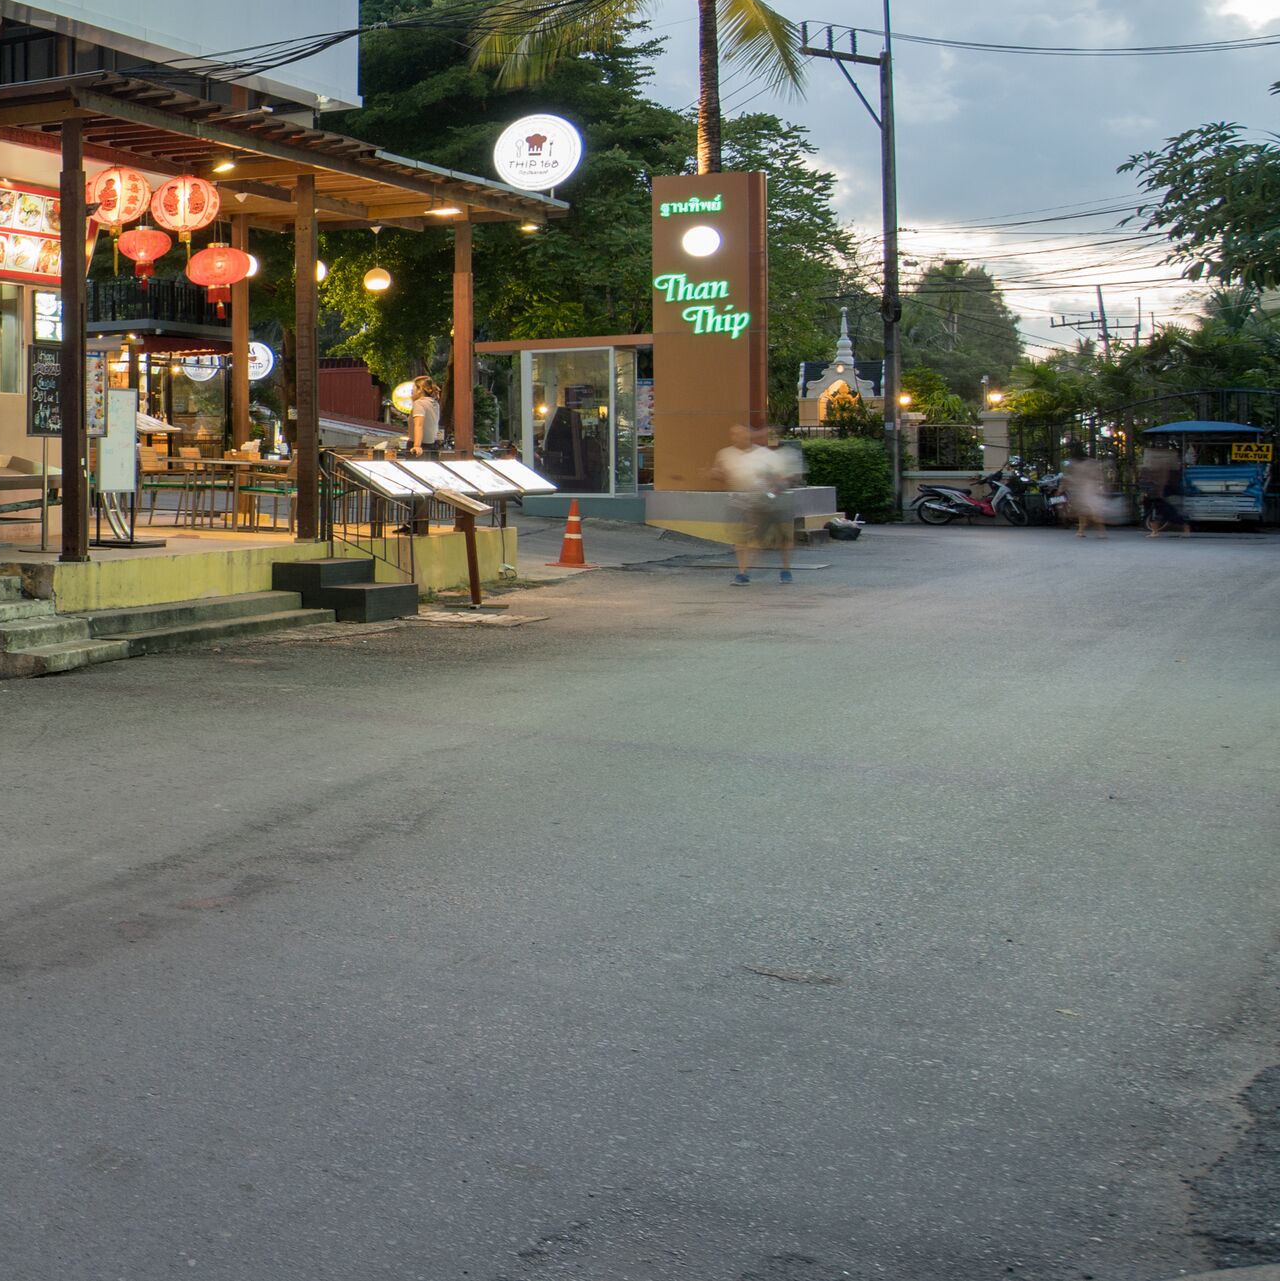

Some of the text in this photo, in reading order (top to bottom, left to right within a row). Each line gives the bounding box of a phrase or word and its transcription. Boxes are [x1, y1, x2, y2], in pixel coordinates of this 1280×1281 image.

[509, 159, 559, 168] THIP 168
[660, 194, 722, 216] ฐานทิพย์
[654, 273, 729, 302] Than
[682, 305, 750, 339] Thip
[1235, 444, 1270, 452] TAXI
